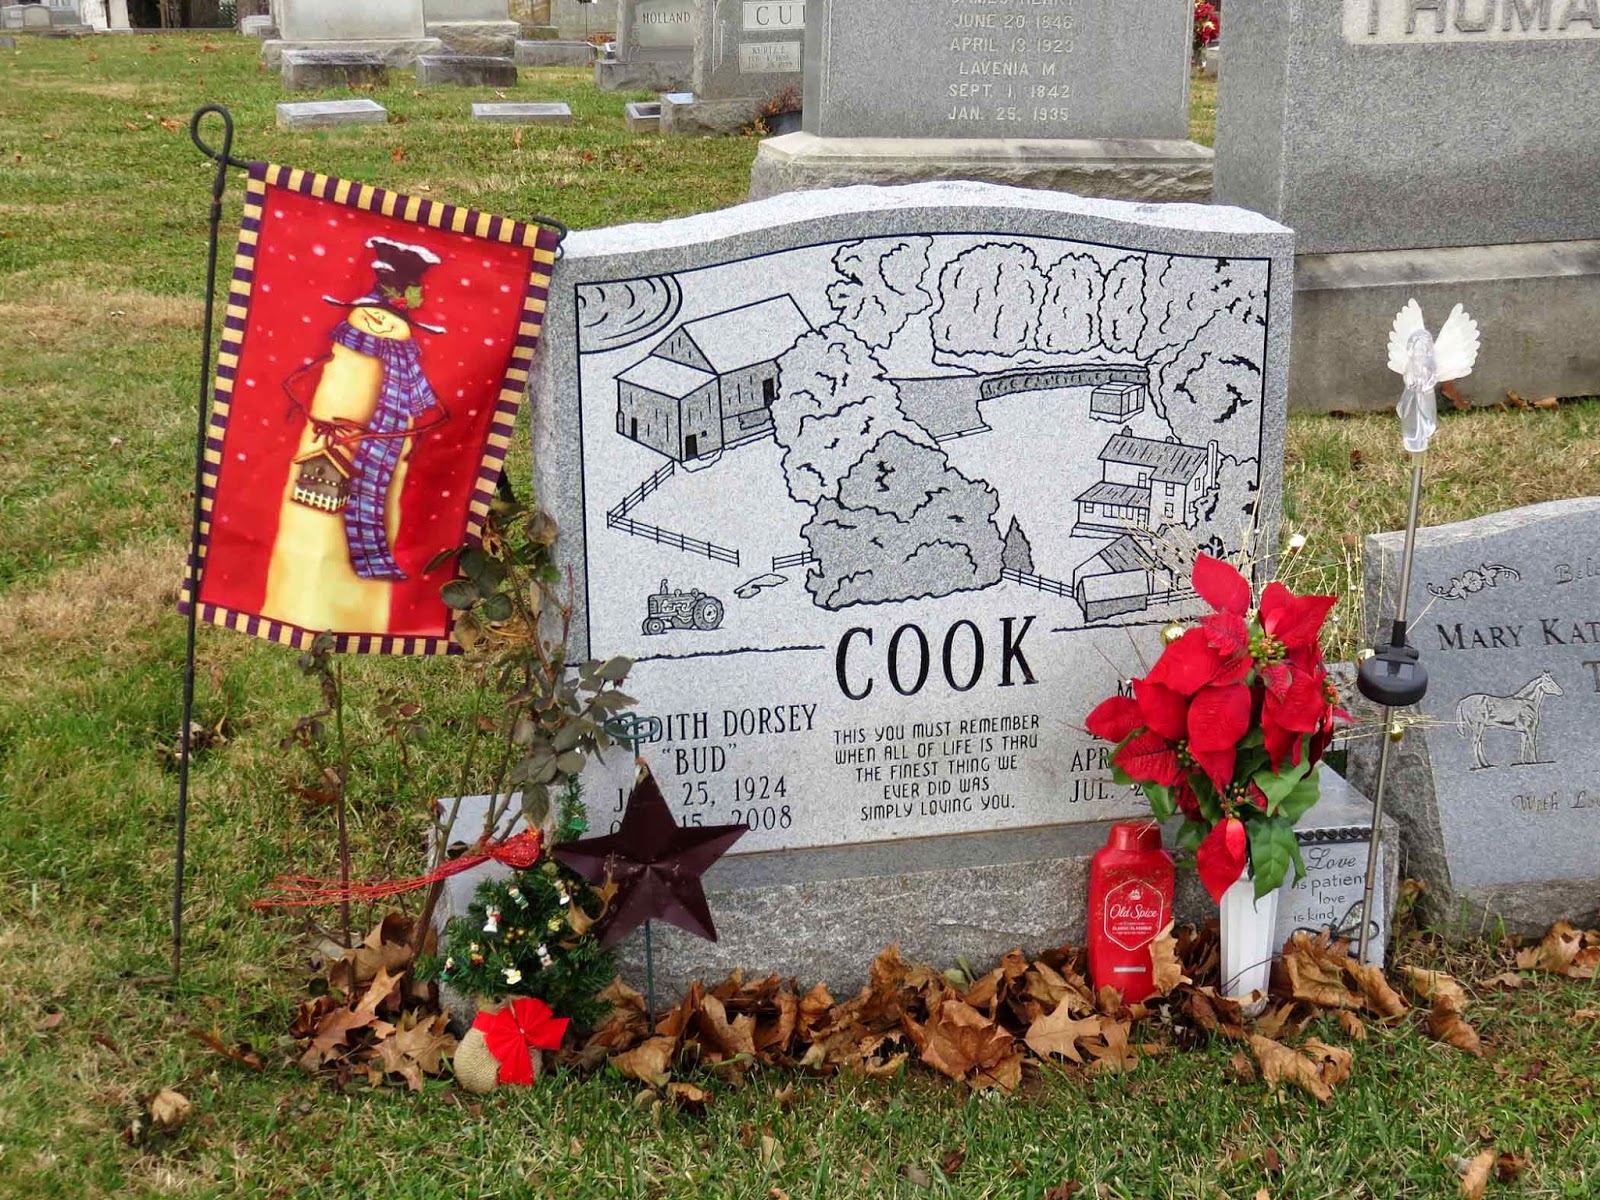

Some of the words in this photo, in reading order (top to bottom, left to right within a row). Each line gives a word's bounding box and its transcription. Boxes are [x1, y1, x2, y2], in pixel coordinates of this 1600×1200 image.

[642, 12, 691, 25] HOLLAND
[755, 5, 805, 26] CU
[955, 13, 997, 28] JUNE
[950, 37, 998, 52] APRIL
[1037, 38, 1074, 53] 1923
[959, 61, 1029, 76] LAVENIA
[1031, 84, 1070, 99] 1842
[1033, 105, 1070, 121] 1935
[1436, 622, 1524, 650] MARY
[835, 615, 1040, 701] COOK
[723, 703, 818, 738] DORSEY
[834, 728, 866, 745] THIS
[875, 725, 904, 742] YOU
[913, 721, 951, 738] MUST
[960, 714, 1040, 735] REMEMBER
[835, 747, 876, 765] WHEN
[884, 745, 909, 760] ALL
[917, 742, 935, 758] OF
[943, 739, 972, 756] LIFE
[980, 737, 993, 753] IS
[1002, 734, 1038, 750] THRU
[855, 766, 882, 783] THE
[891, 761, 938, 780] FINEST
[949, 758, 990, 775] THING
[998, 755, 1018, 770] WE
[682, 780, 716, 808] 25,
[734, 774, 787, 802] 1924
[884, 783, 920, 800] EVER
[928, 780, 951, 796] DID
[959, 776, 990, 793] WAS
[1069, 778, 1115, 803] JUL.
[731, 804, 792, 832] 2008
[860, 803, 913, 821] SIMPLY
[921, 797, 972, 816] LOVING
[980, 793, 1015, 811] YOU.
[1306, 847, 1357, 871] Love
[1319, 891, 1346, 905] love
[1110, 904, 1131, 919] Old
[1130, 904, 1158, 920] Spice
[1293, 914, 1305, 923] is
[1308, 906, 1335, 921] kind
